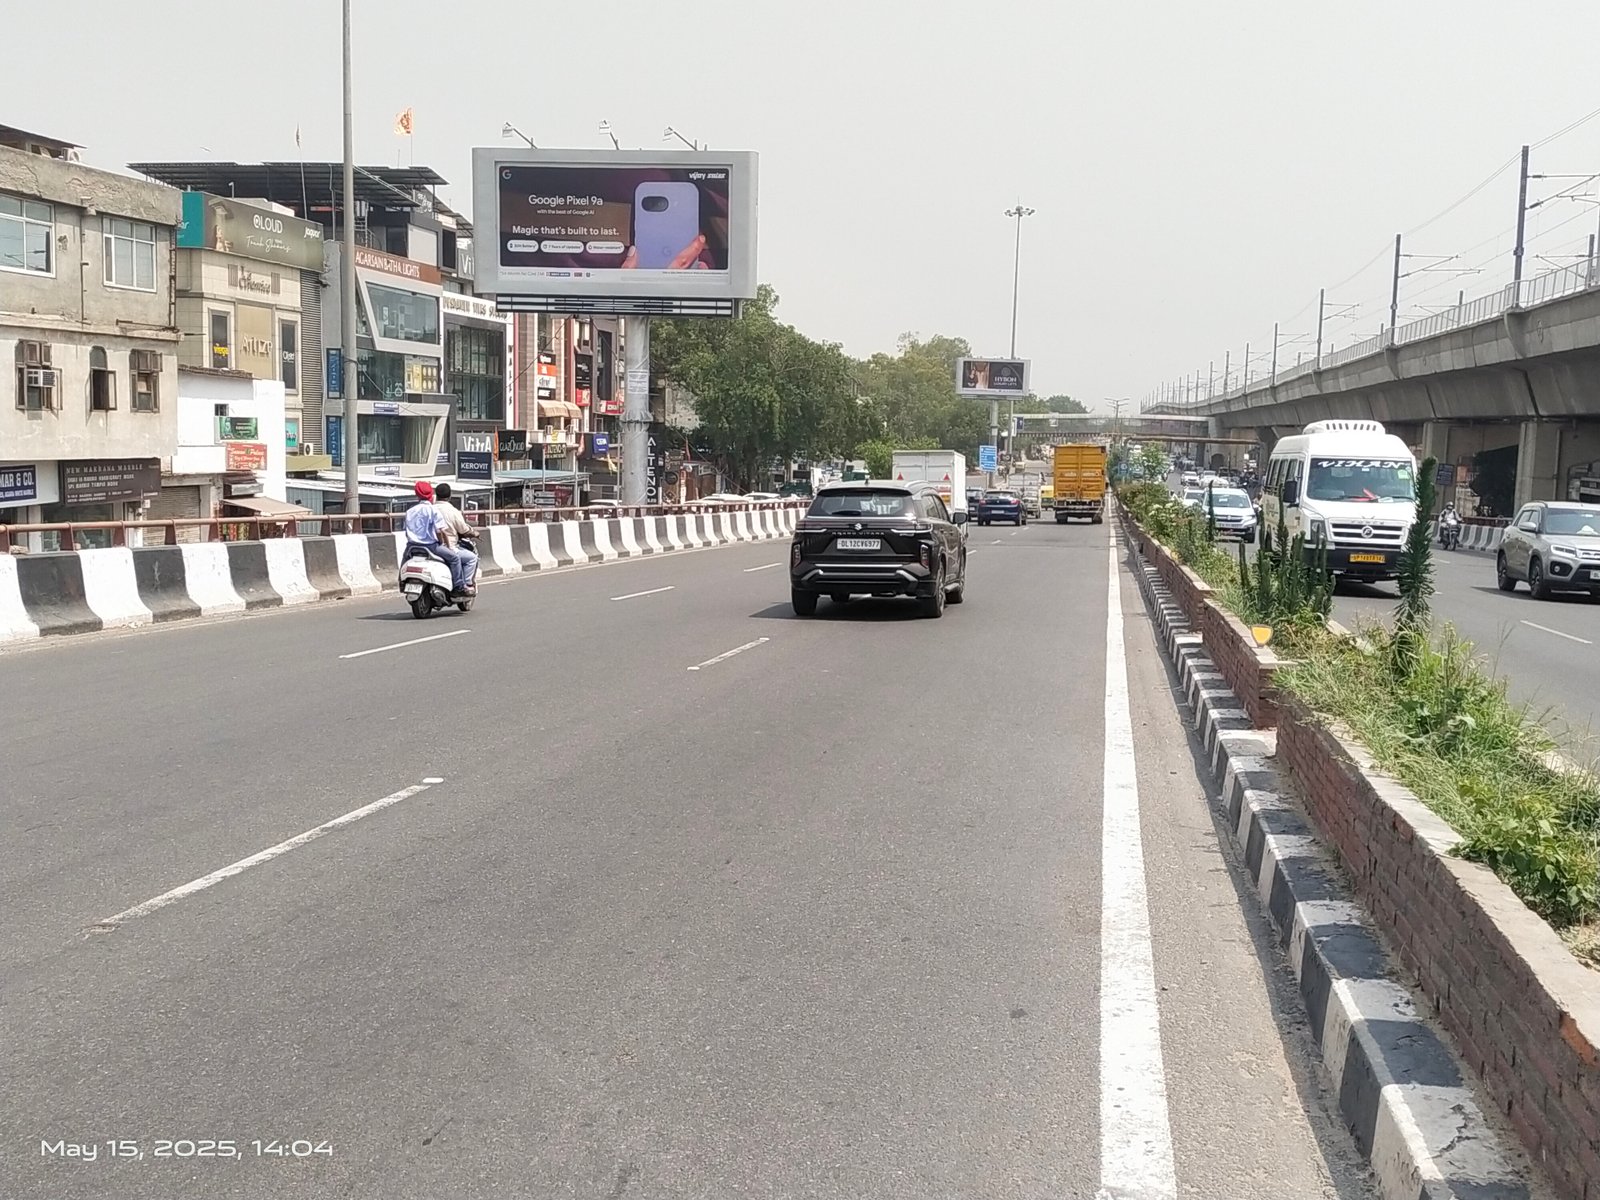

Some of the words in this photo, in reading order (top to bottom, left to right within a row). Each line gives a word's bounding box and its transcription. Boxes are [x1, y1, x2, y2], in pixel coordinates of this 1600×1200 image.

[528, 194, 565, 208] Google
[567, 195, 589, 206] Pixel
[591, 196, 604, 206] 9a
[512, 225, 539, 236] Magic
[541, 225, 566, 235] that's
[567, 226, 588, 235] built
[589, 227, 599, 236] to
[600, 227, 620, 236] last.
[402, 263, 420, 278] LIGHTS
[84, 465, 115, 473] MAKRANA
[460, 462, 488, 470] KEROVIT
[646, 436, 657, 496] ALTENO
[16, 473, 21, 486] &
[23, 471, 34, 486] CO.
